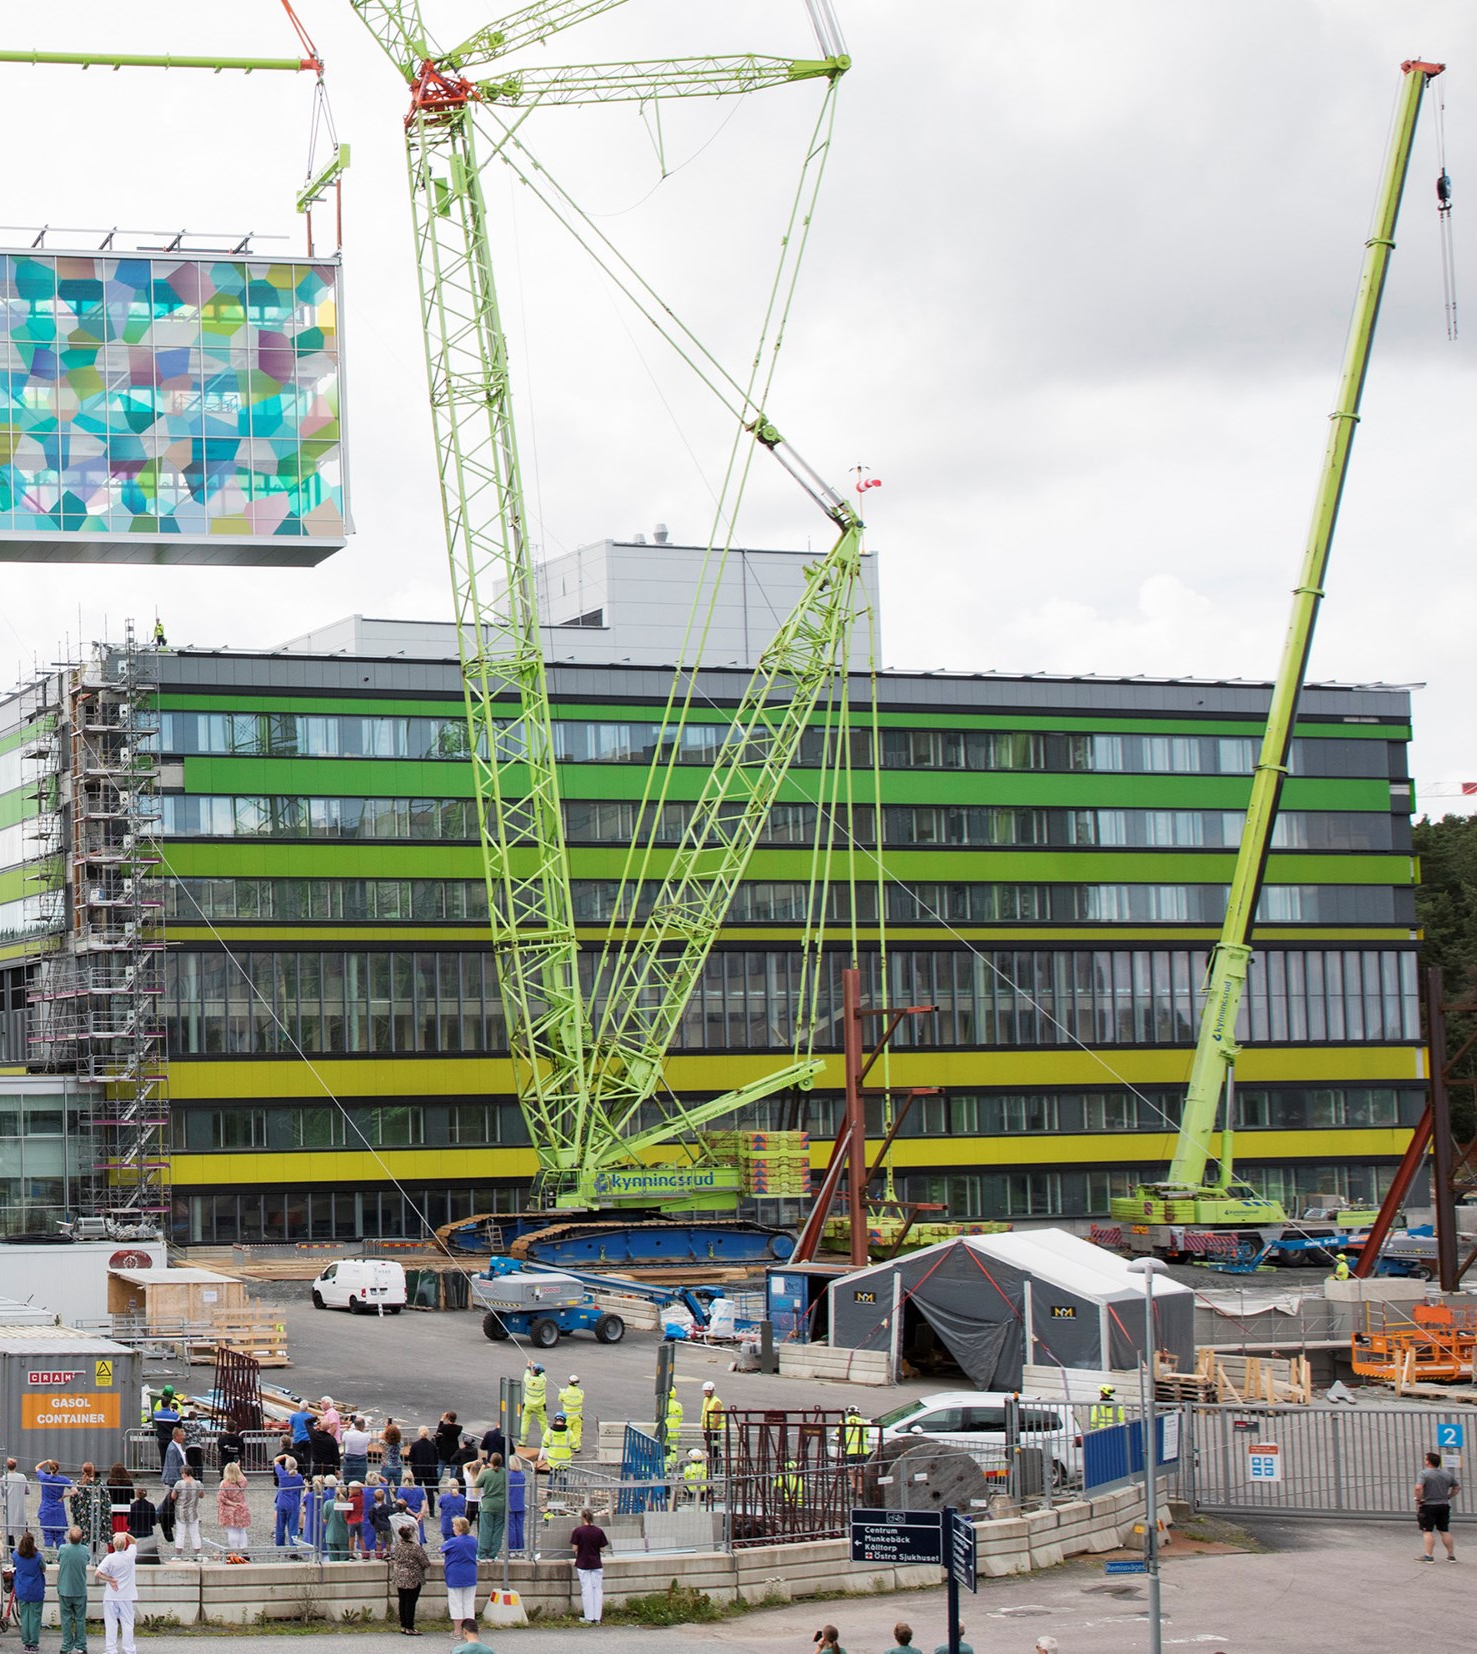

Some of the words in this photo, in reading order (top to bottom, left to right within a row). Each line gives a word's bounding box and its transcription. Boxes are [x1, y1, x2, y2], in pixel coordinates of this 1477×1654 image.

[51, 1398, 91, 1408] GASOL
[36, 1413, 105, 1424] CONTAINER
[1443, 1427, 1457, 1445] 2
[864, 1526, 898, 1534] Centrum
[864, 1535, 911, 1543] Munkebäck
[874, 1551, 897, 1560] Östra
[899, 1553, 939, 1562] Sjukhuset
